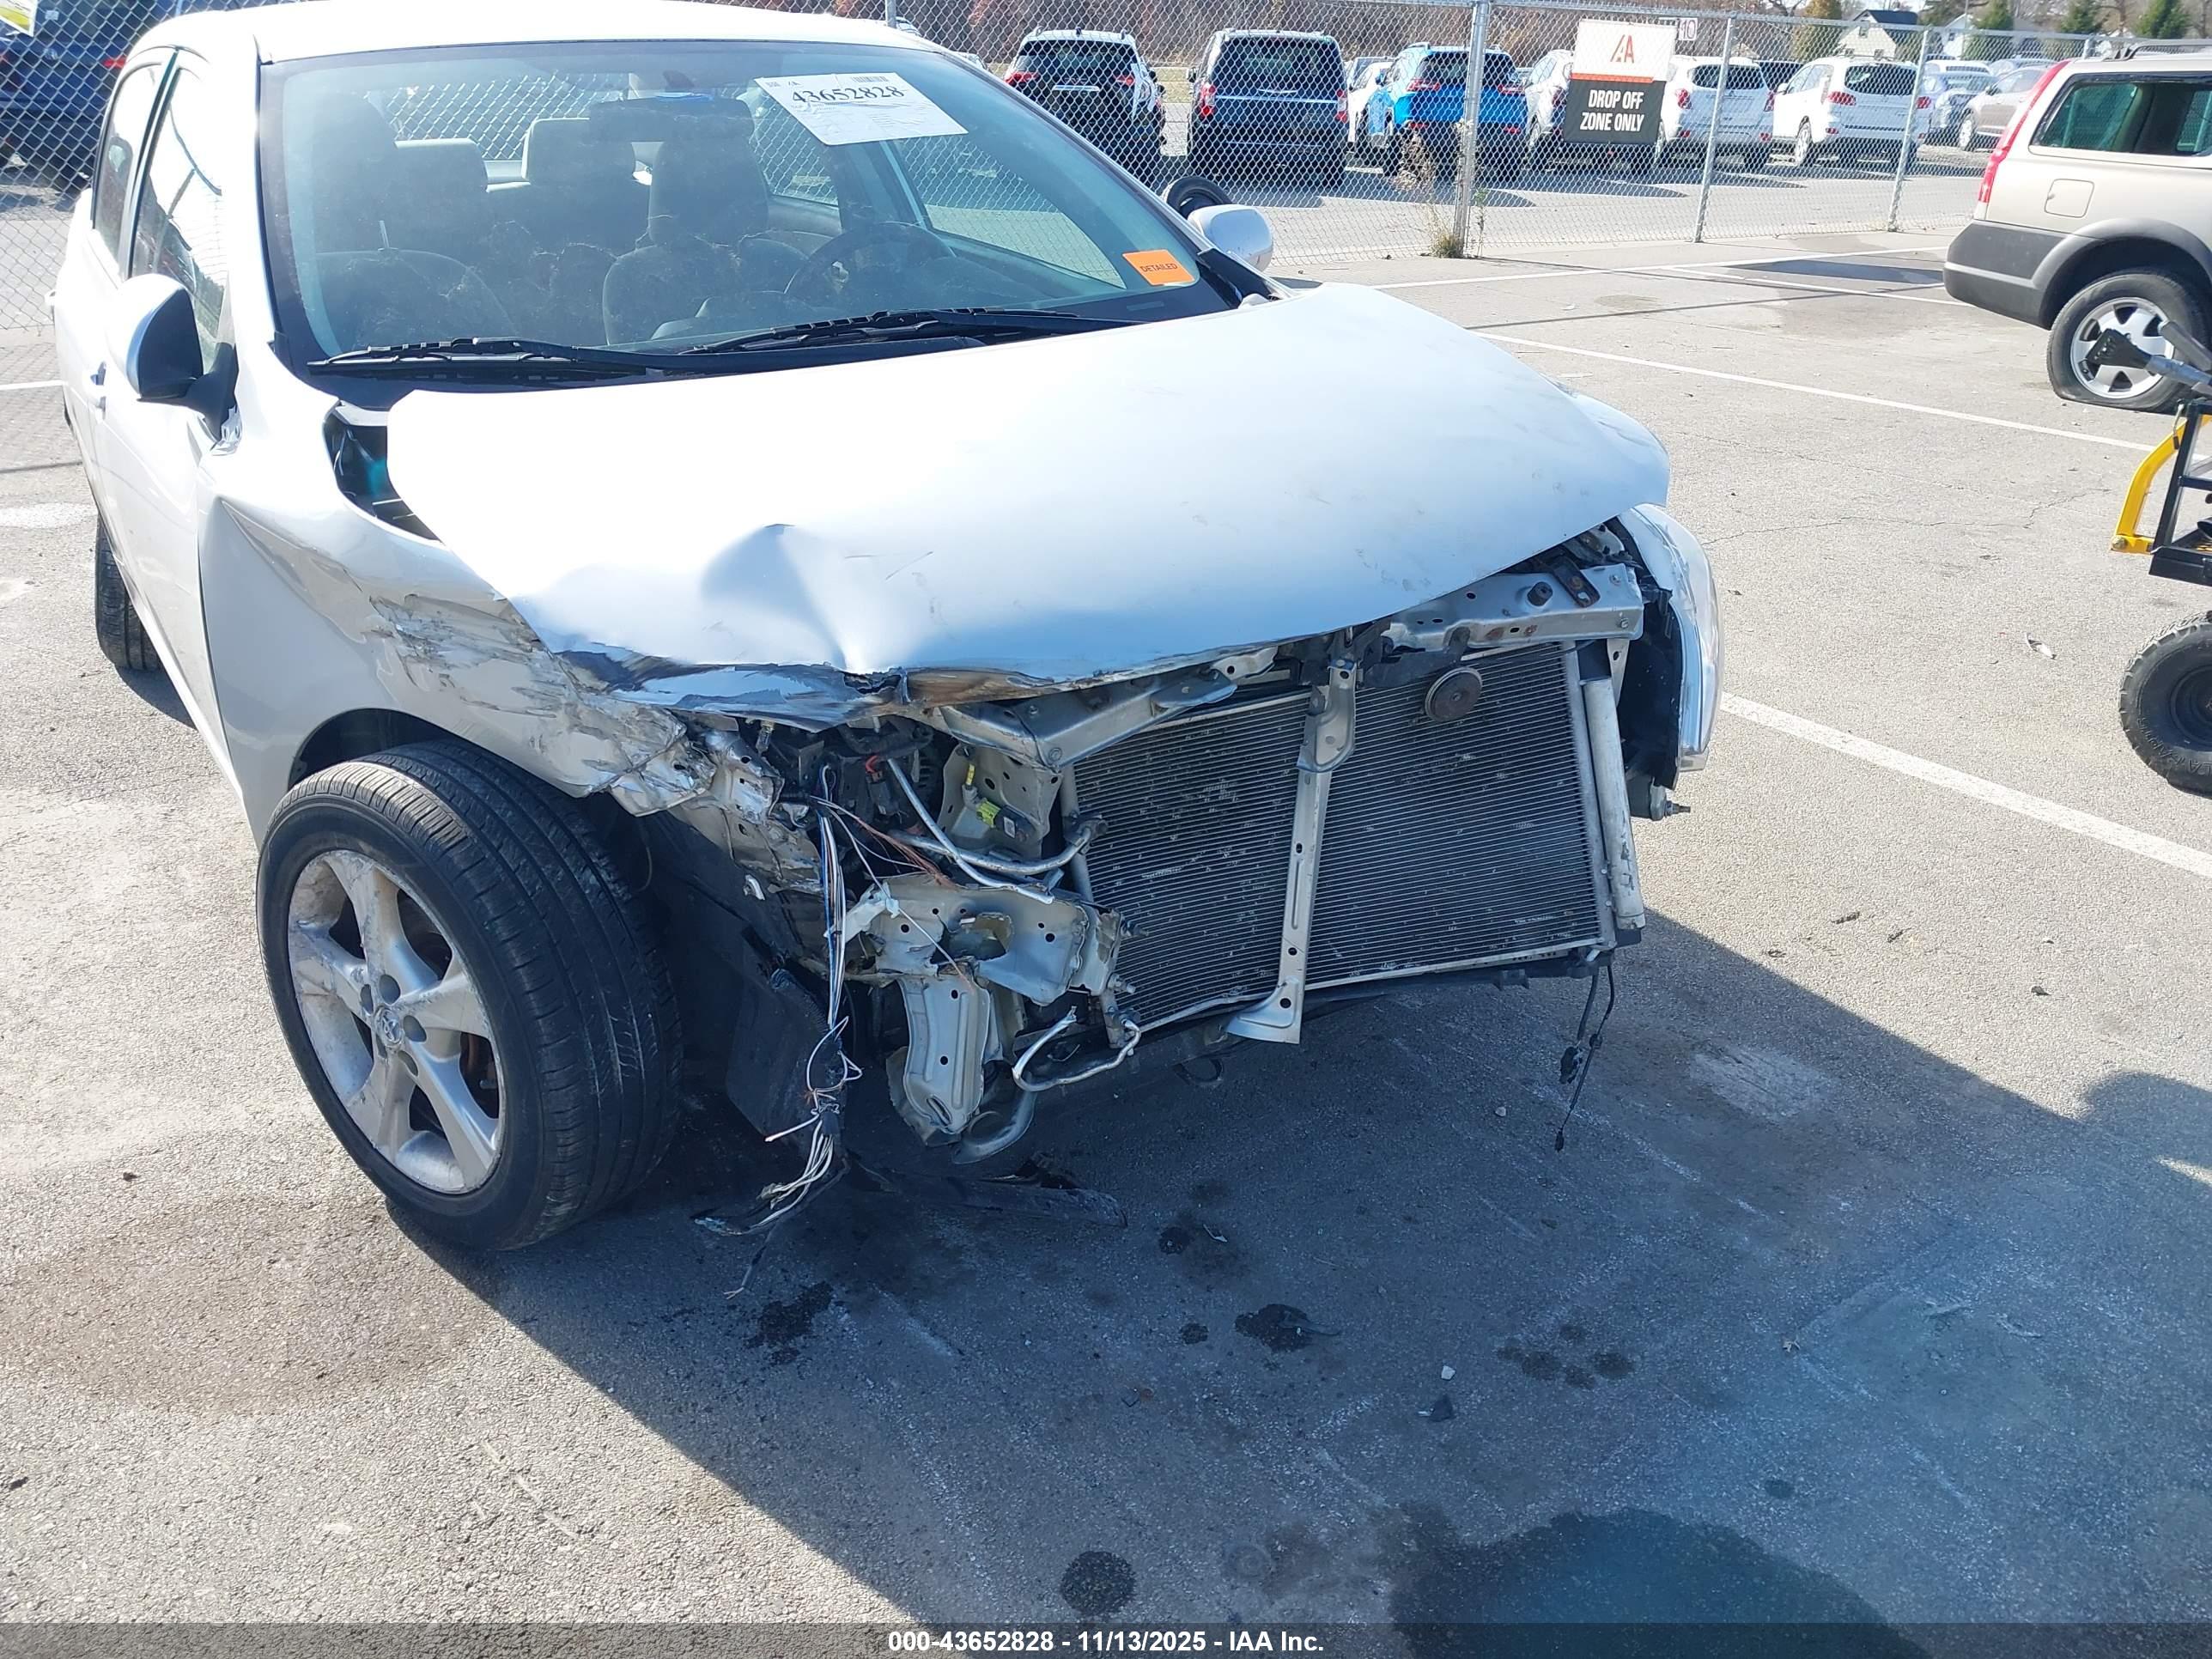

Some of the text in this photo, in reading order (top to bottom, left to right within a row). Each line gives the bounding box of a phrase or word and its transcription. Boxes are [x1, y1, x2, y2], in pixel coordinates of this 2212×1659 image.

[792, 86, 905, 103] 43652828
[1589, 89, 1644, 110] DROP OFF
[1580, 112, 1644, 132] ZONE ONLY
[1140, 263, 1177, 272] DETAILED
